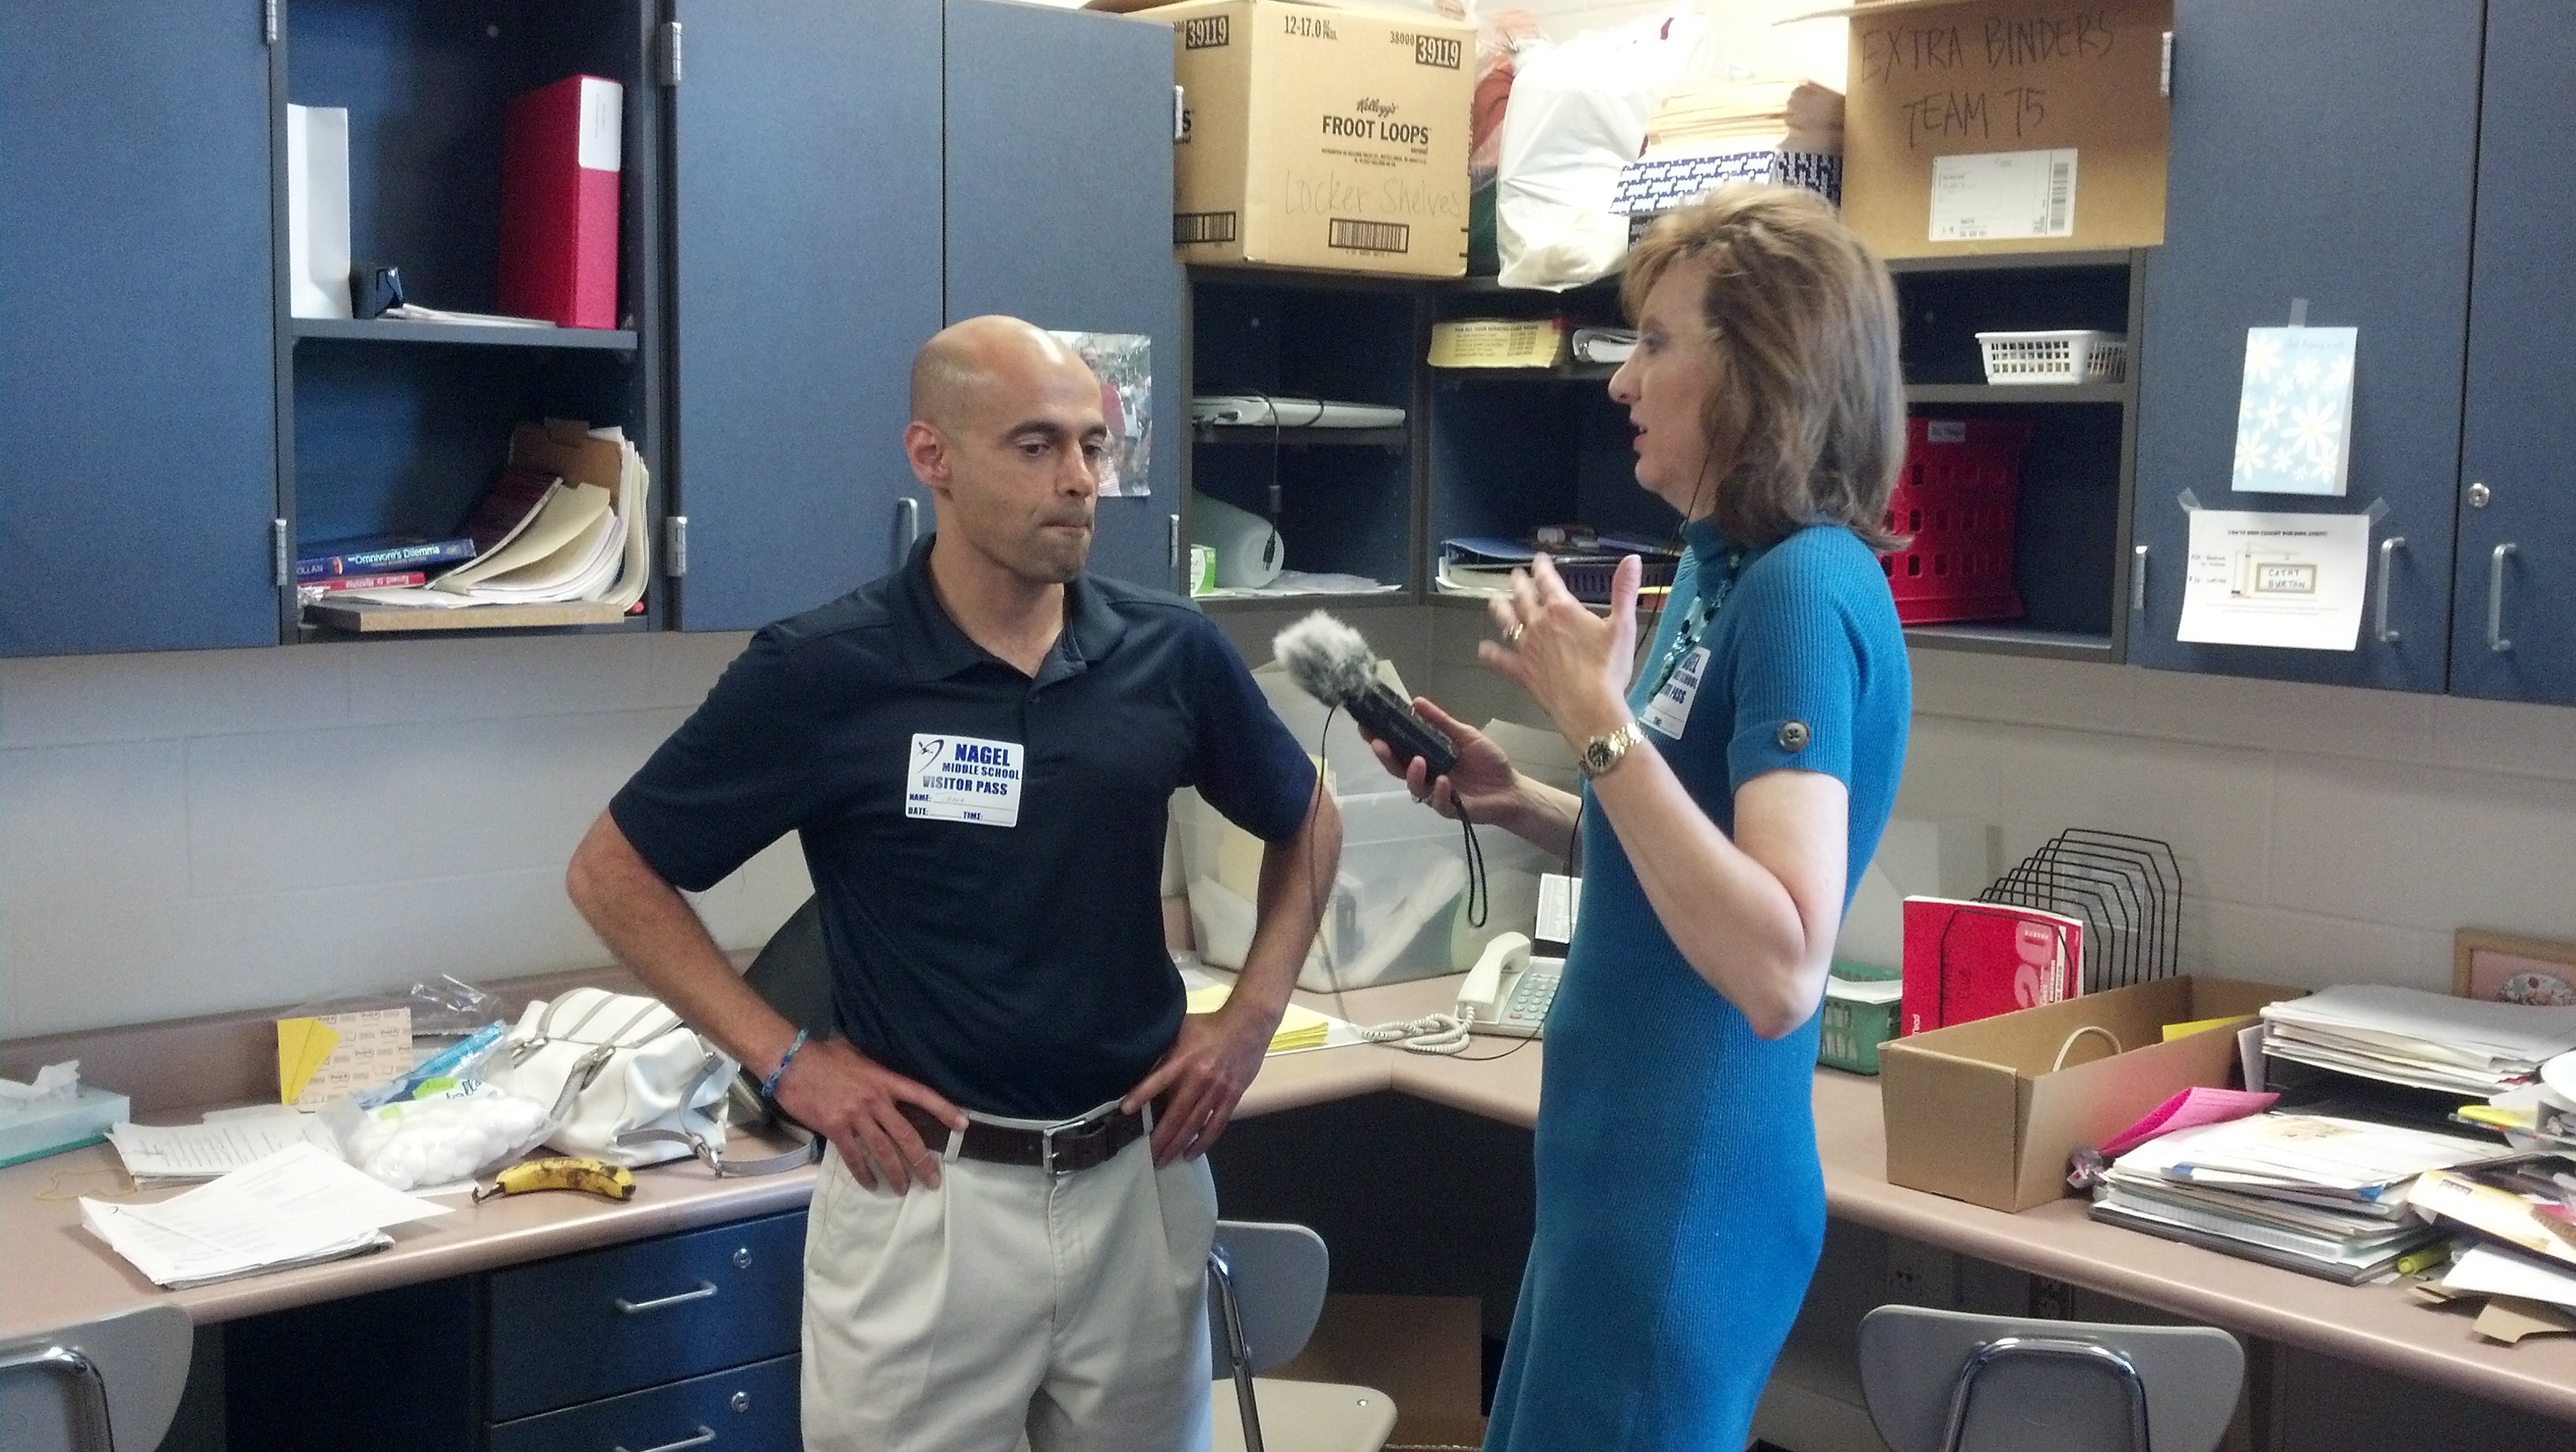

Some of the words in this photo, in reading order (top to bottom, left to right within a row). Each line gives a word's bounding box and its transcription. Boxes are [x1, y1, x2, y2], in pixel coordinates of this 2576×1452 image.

[1187, 17, 1227, 47] 39119
[1389, 31, 1414, 46] 38000
[1417, 36, 1459, 67] 39119
[1861, 24, 1964, 84] EXTRA
[1985, 13, 2114, 69] BINDERS
[1356, 96, 1396, 118] Kellogg's
[1903, 90, 1989, 148] TEAM
[2005, 87, 2046, 138] 75
[1321, 114, 1375, 140] FROOT
[1380, 121, 1429, 145] LOOPS
[1285, 170, 1368, 215] Locker
[1380, 178, 1461, 217] Shelves
[403, 545, 440, 559] Dilemma
[954, 743, 1011, 767] NAGEL
[922, 775, 973, 791] VISITOR
[976, 780, 1009, 795] PASS
[942, 762, 979, 775] MIDDLE
[981, 766, 1020, 780] SCHOOL
